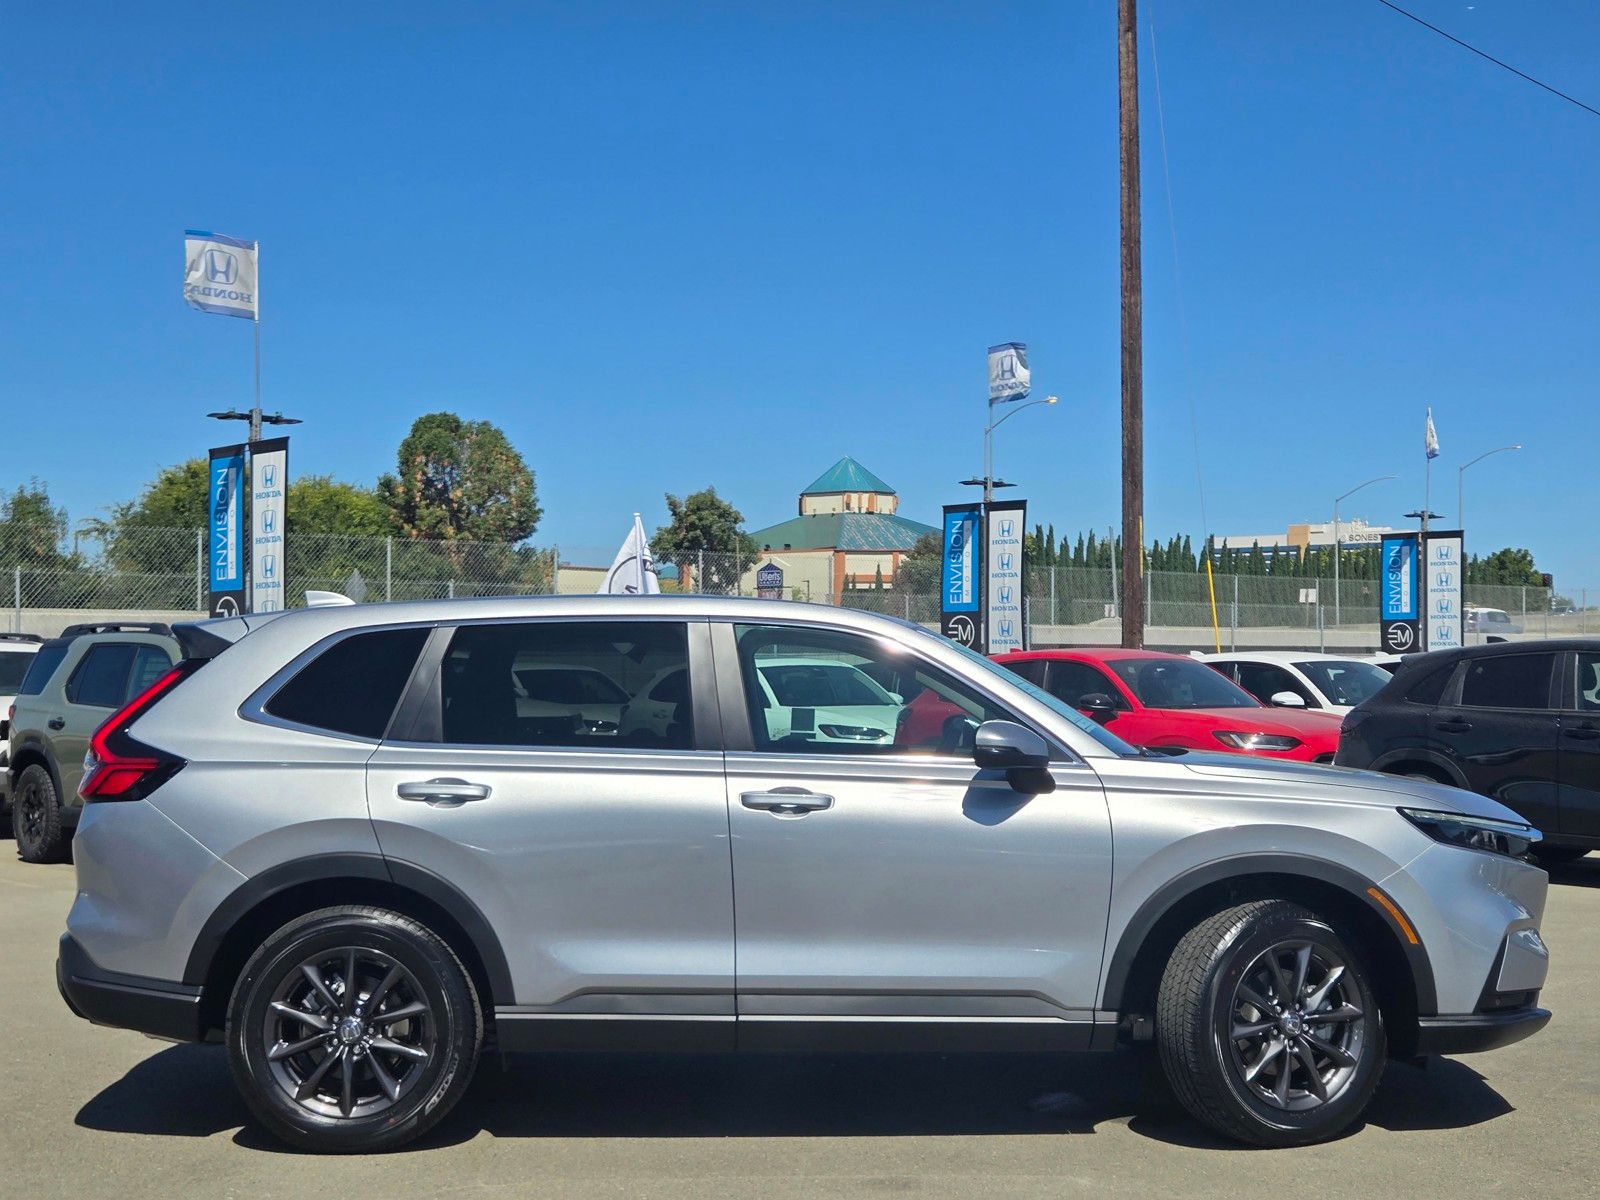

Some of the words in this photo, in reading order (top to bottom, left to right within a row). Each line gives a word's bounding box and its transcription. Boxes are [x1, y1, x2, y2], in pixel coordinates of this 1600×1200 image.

[255, 489, 282, 499] HONDA
[217, 468, 229, 580] ENVISION
[255, 535, 282, 545] HONDA
[1348, 534, 1381, 542] SONES
[950, 520, 963, 604] ENVISION
[255, 580, 282, 590] HONDA
[1389, 546, 1401, 614] ENVISION
